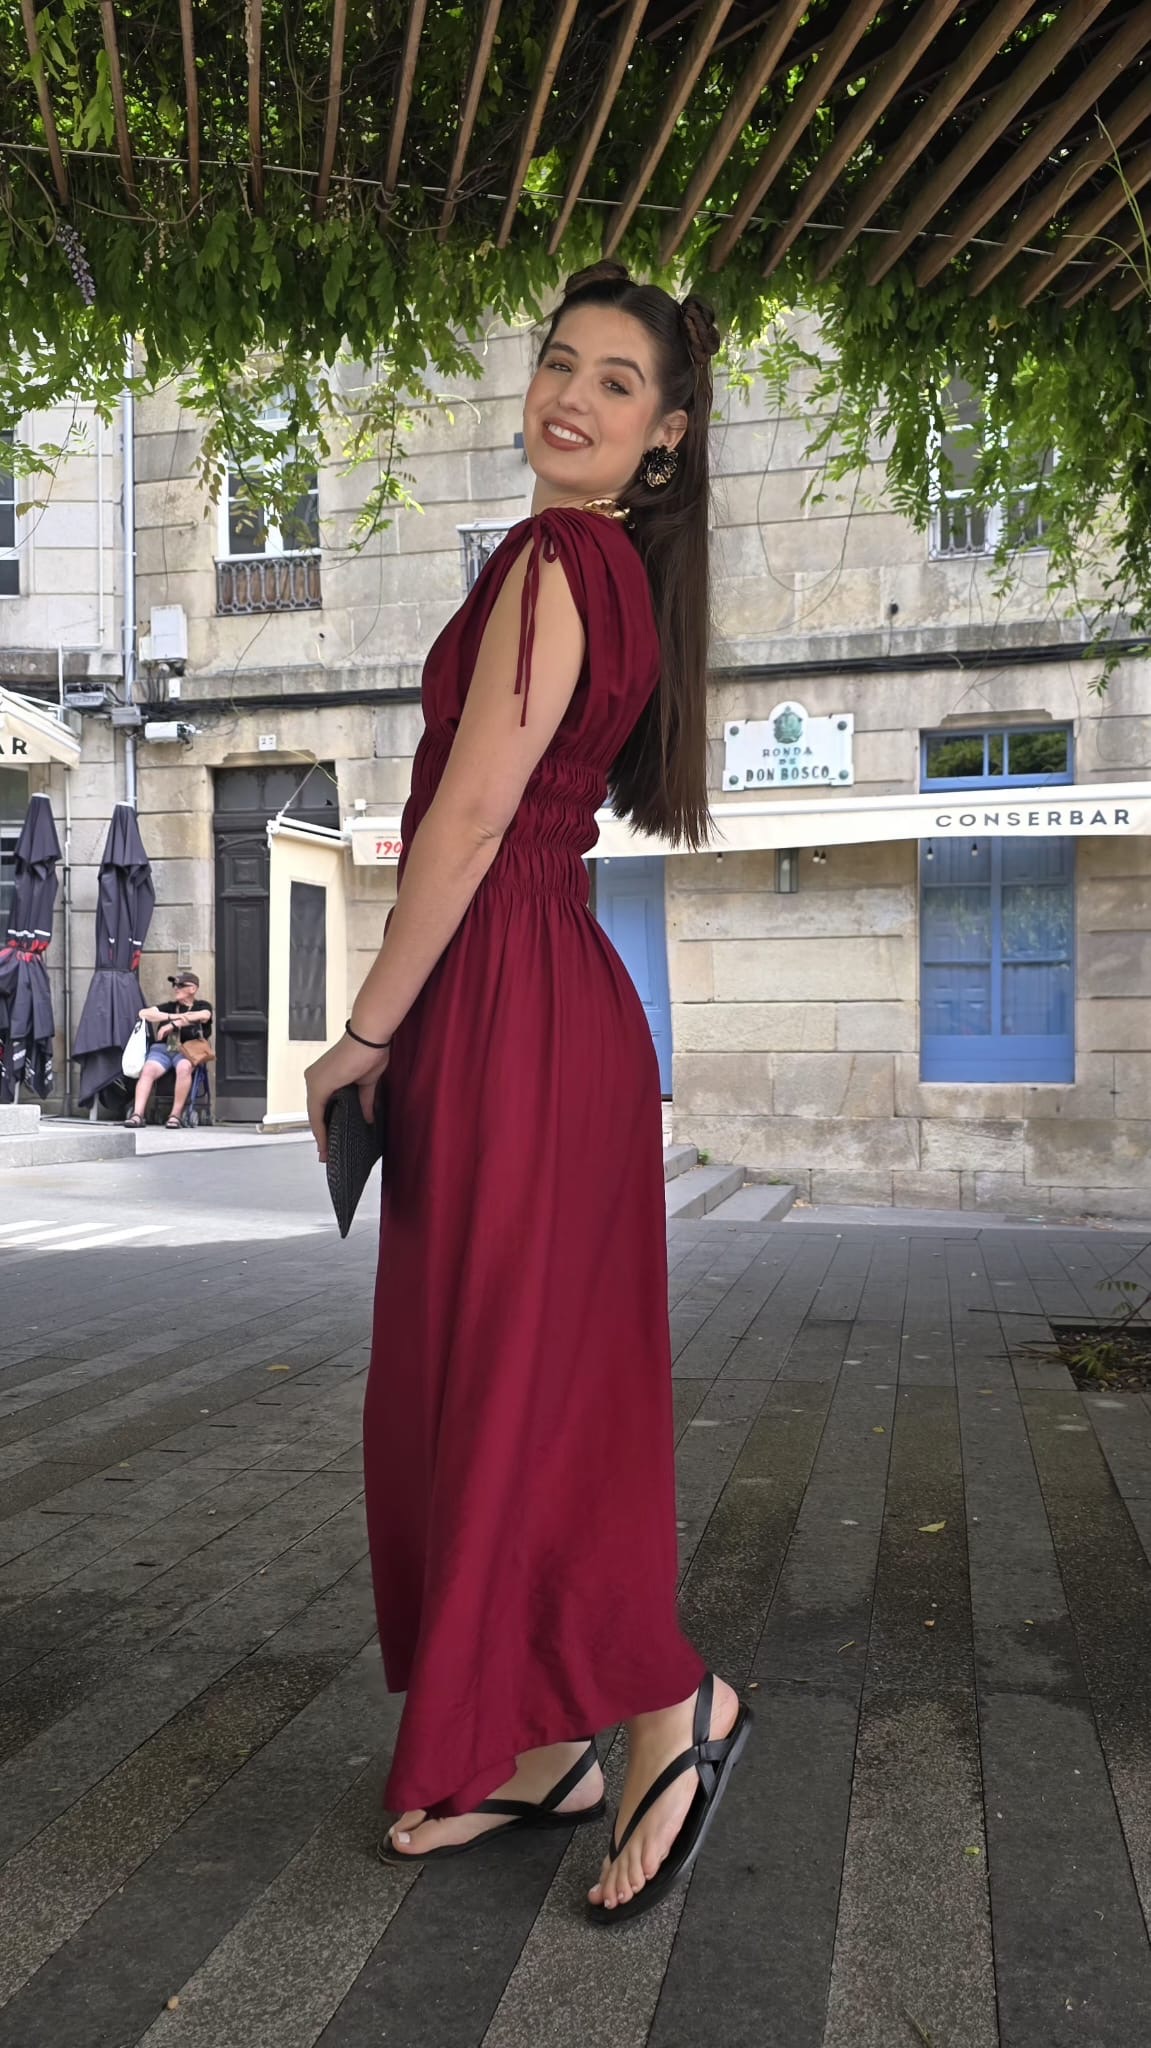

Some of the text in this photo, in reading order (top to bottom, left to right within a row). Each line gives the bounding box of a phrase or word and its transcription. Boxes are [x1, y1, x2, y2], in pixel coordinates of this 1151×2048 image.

[0, 737, 27, 754] R
[762, 747, 812, 757] RONDA
[746, 766, 829, 782] DON BOSCO
[936, 809, 1129, 827] CONSERBAR
